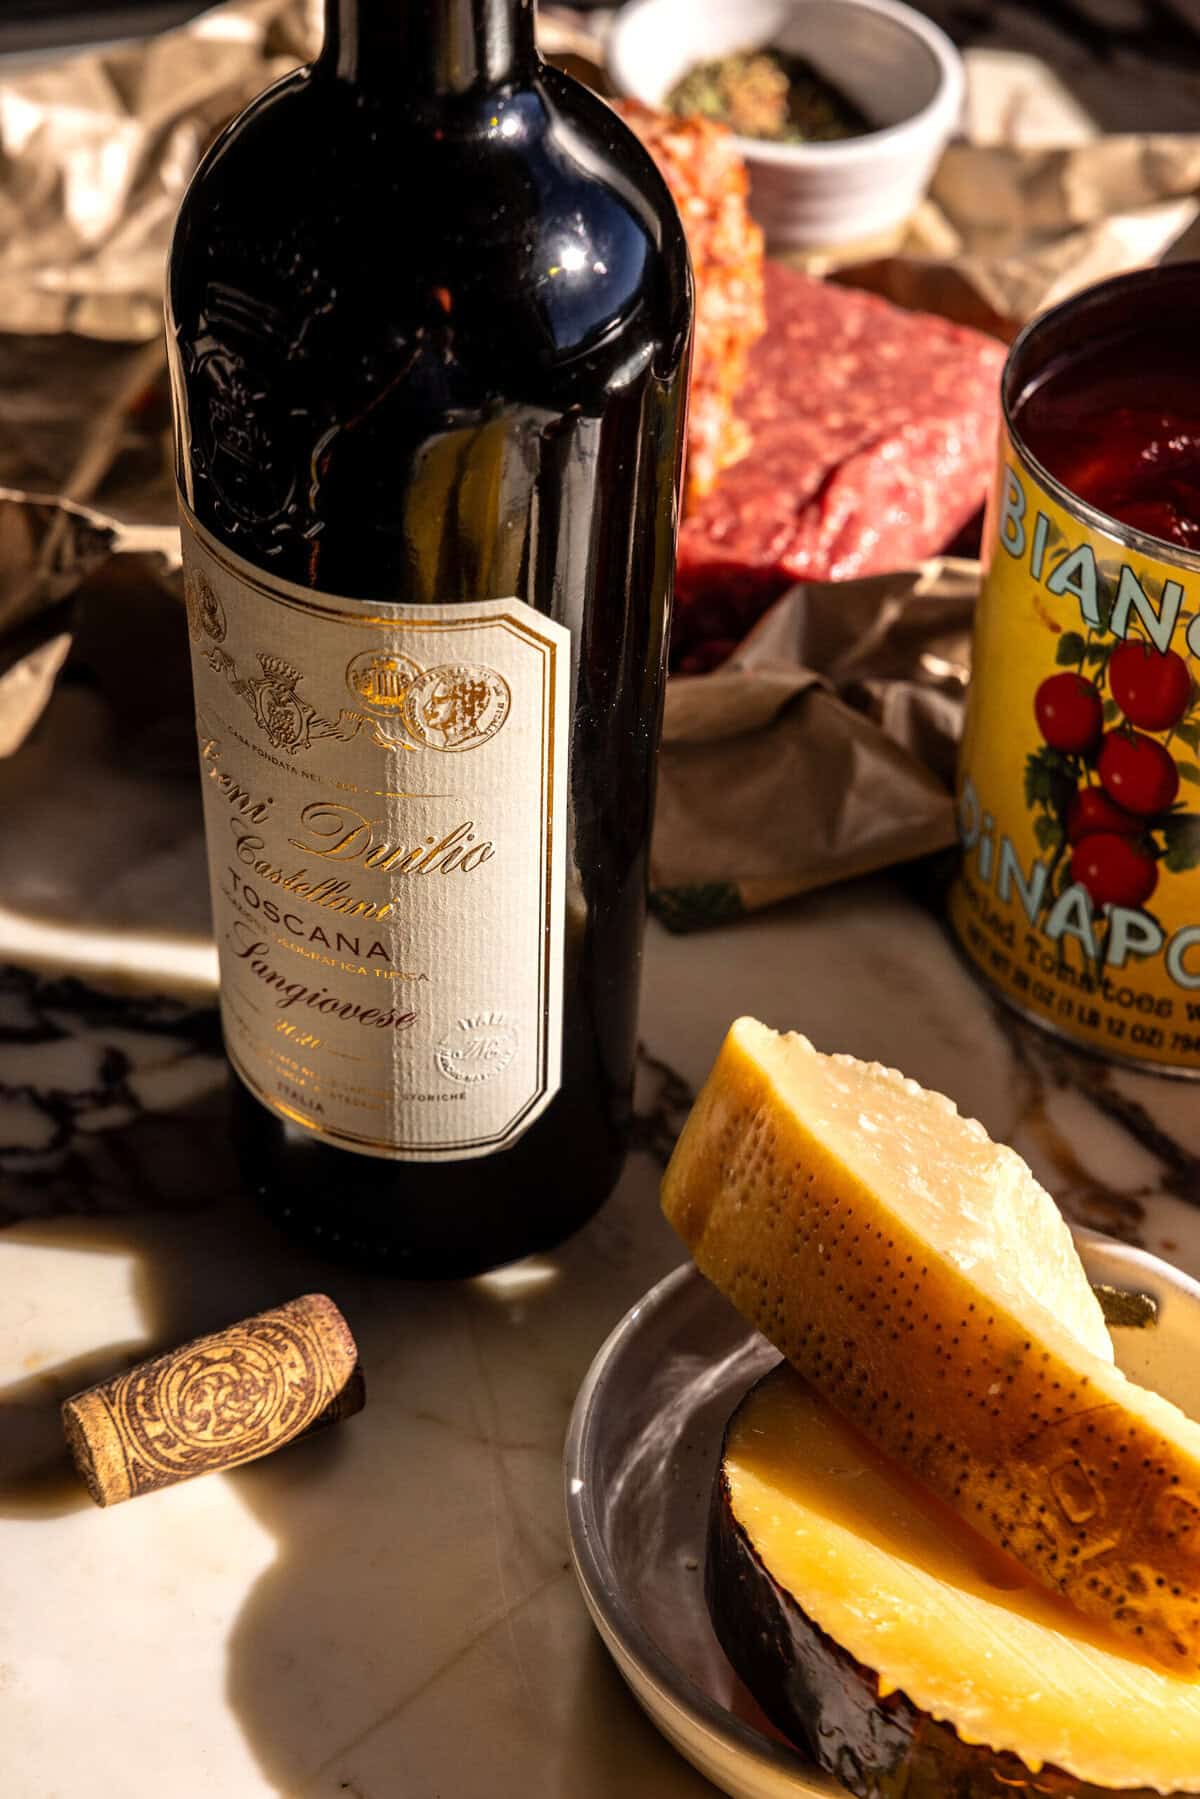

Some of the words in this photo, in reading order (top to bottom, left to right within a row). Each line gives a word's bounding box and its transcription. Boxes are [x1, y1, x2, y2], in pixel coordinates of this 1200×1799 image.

[288, 801, 496, 875] Duilio
[226, 866, 393, 963] TOSCANA
[224, 920, 418, 1032] Sangiovese
